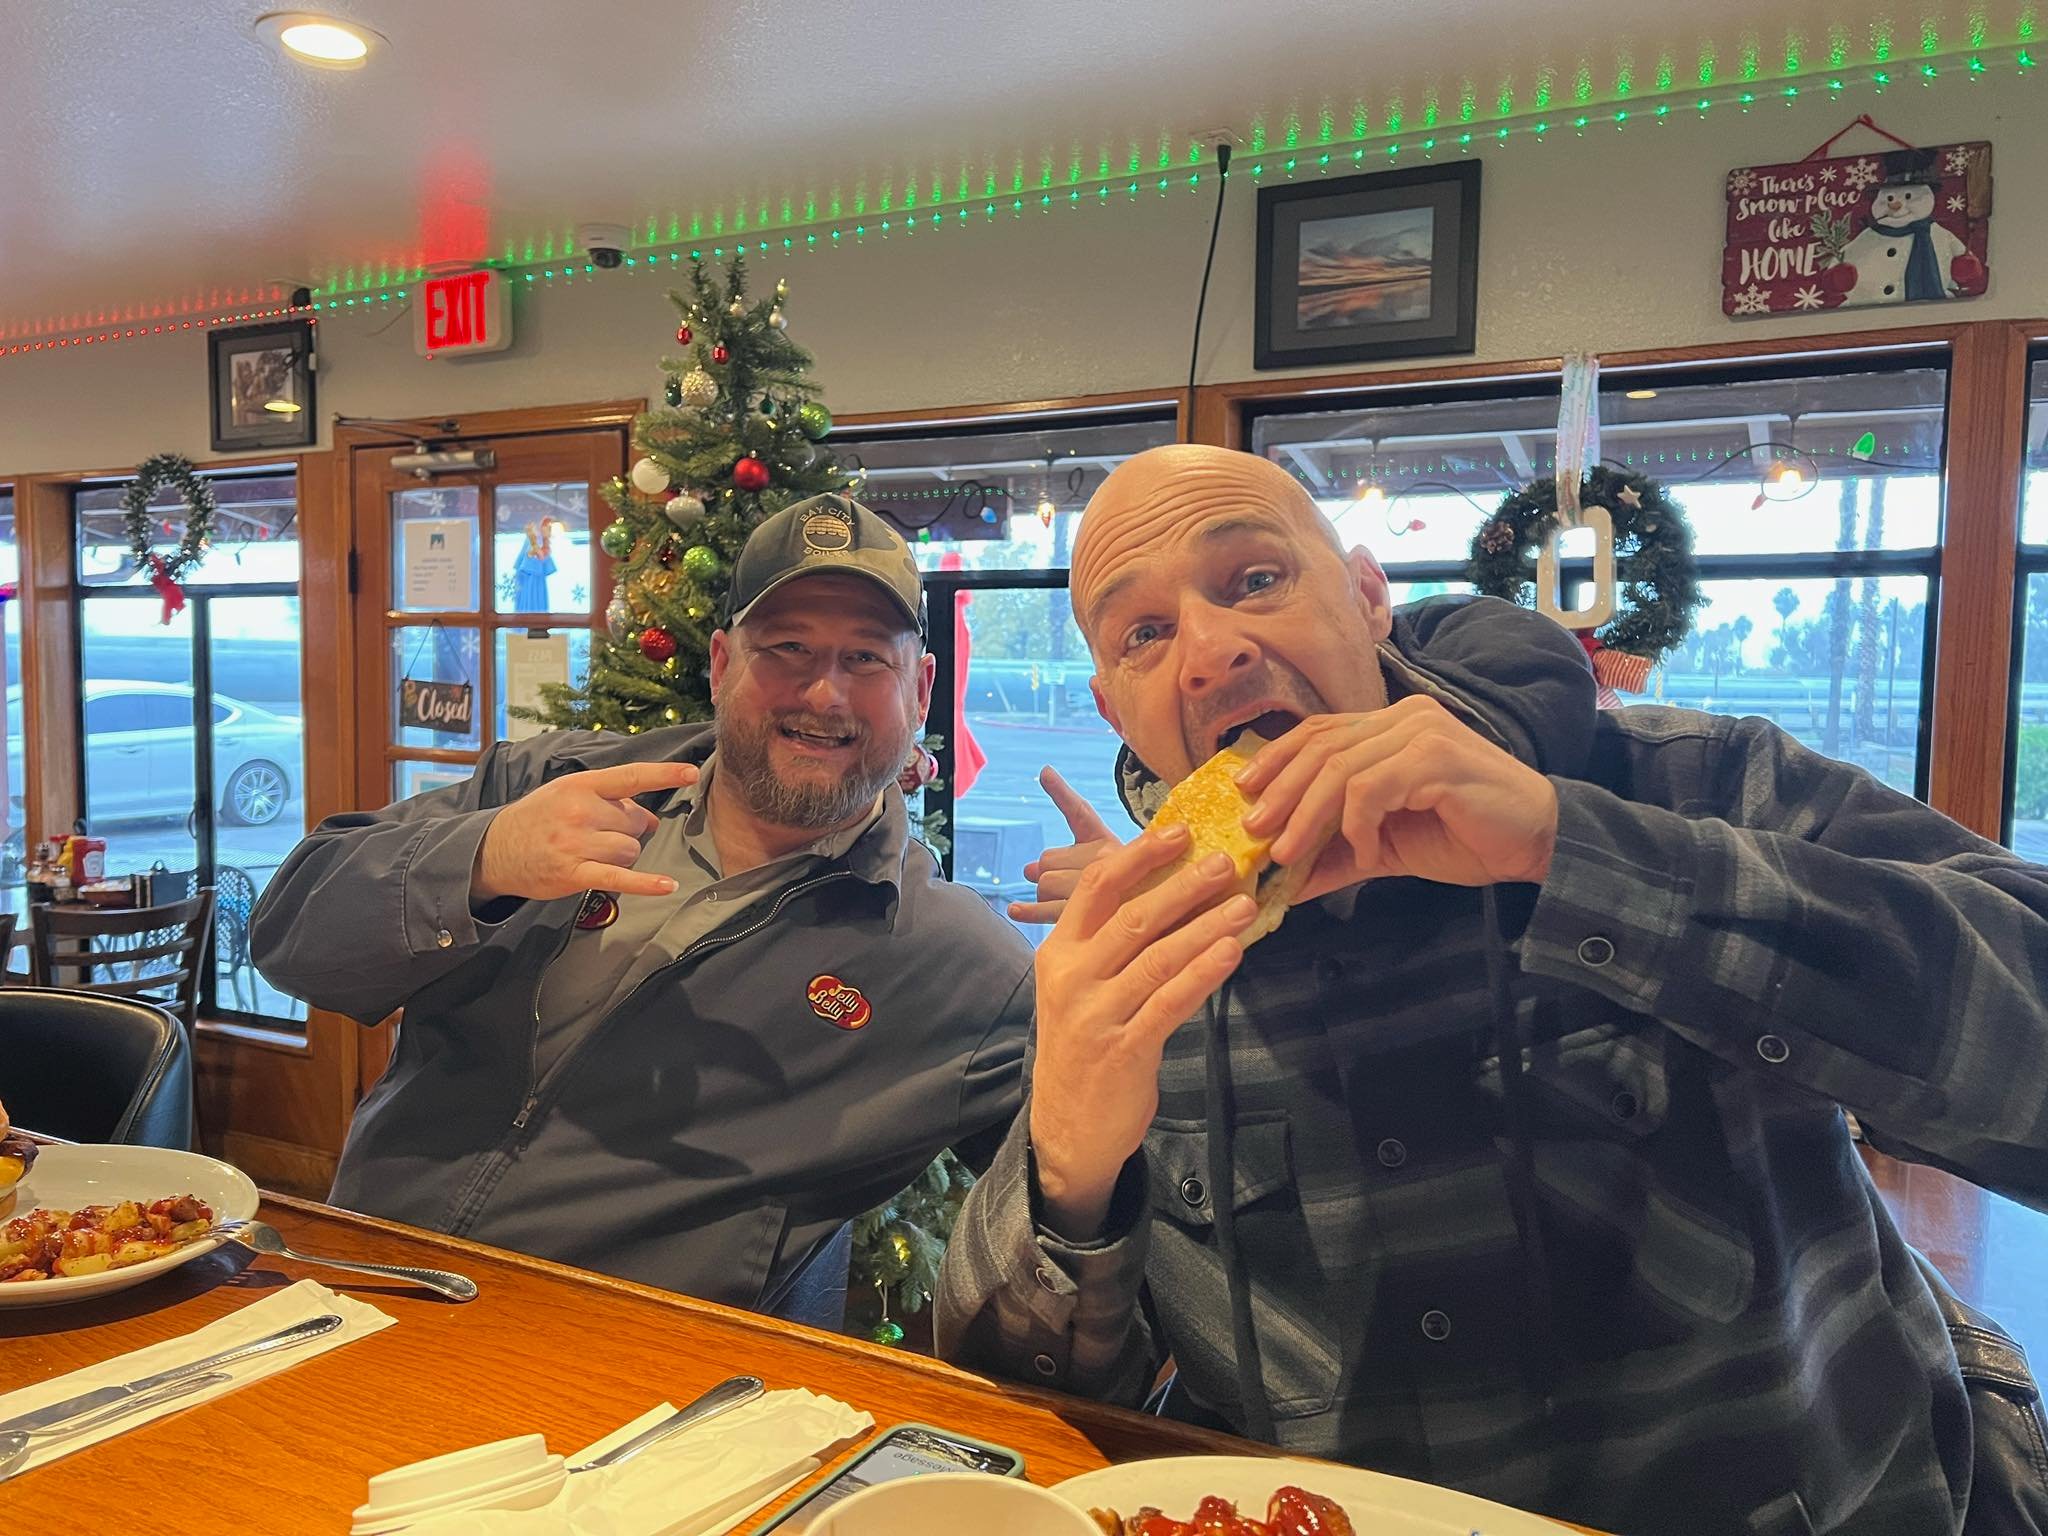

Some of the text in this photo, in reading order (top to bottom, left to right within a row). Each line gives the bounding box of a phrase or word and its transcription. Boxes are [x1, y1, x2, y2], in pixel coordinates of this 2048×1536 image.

[1759, 174, 1815, 196] There's
[1736, 187, 1861, 221] Snow place
[1768, 218, 1806, 243] like
[1740, 241, 1823, 286] HOME
[425, 271, 489, 349] EXIT
[800, 506, 855, 526] BAY CITY
[416, 687, 470, 723] Closed
[808, 989, 845, 1020] Belly
[828, 984, 861, 1013] Jelly
